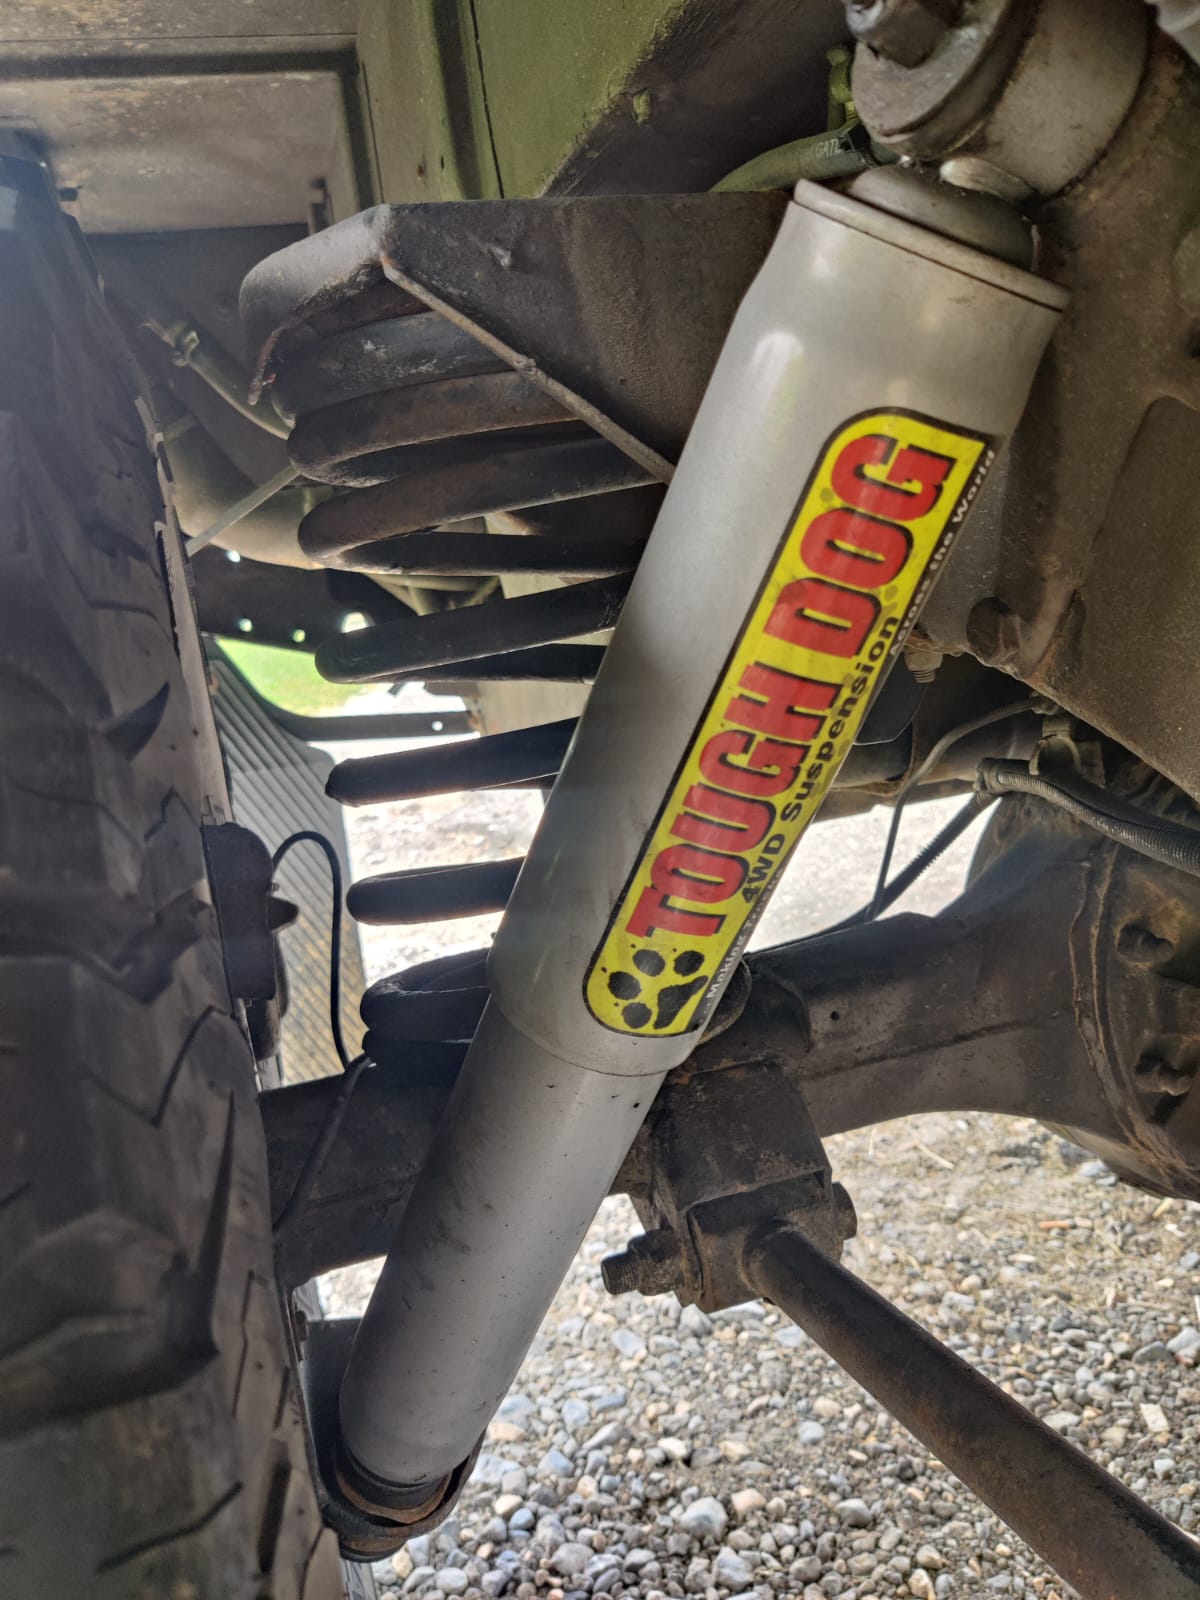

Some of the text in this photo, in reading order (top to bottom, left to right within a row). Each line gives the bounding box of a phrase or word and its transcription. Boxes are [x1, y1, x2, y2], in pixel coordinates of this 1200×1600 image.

[625, 434, 958, 937] TOUGH DOG
[889, 579, 931, 656] Across
[929, 532, 953, 571] the
[951, 450, 995, 524] World
[741, 616, 899, 904] 4WD Suspension
